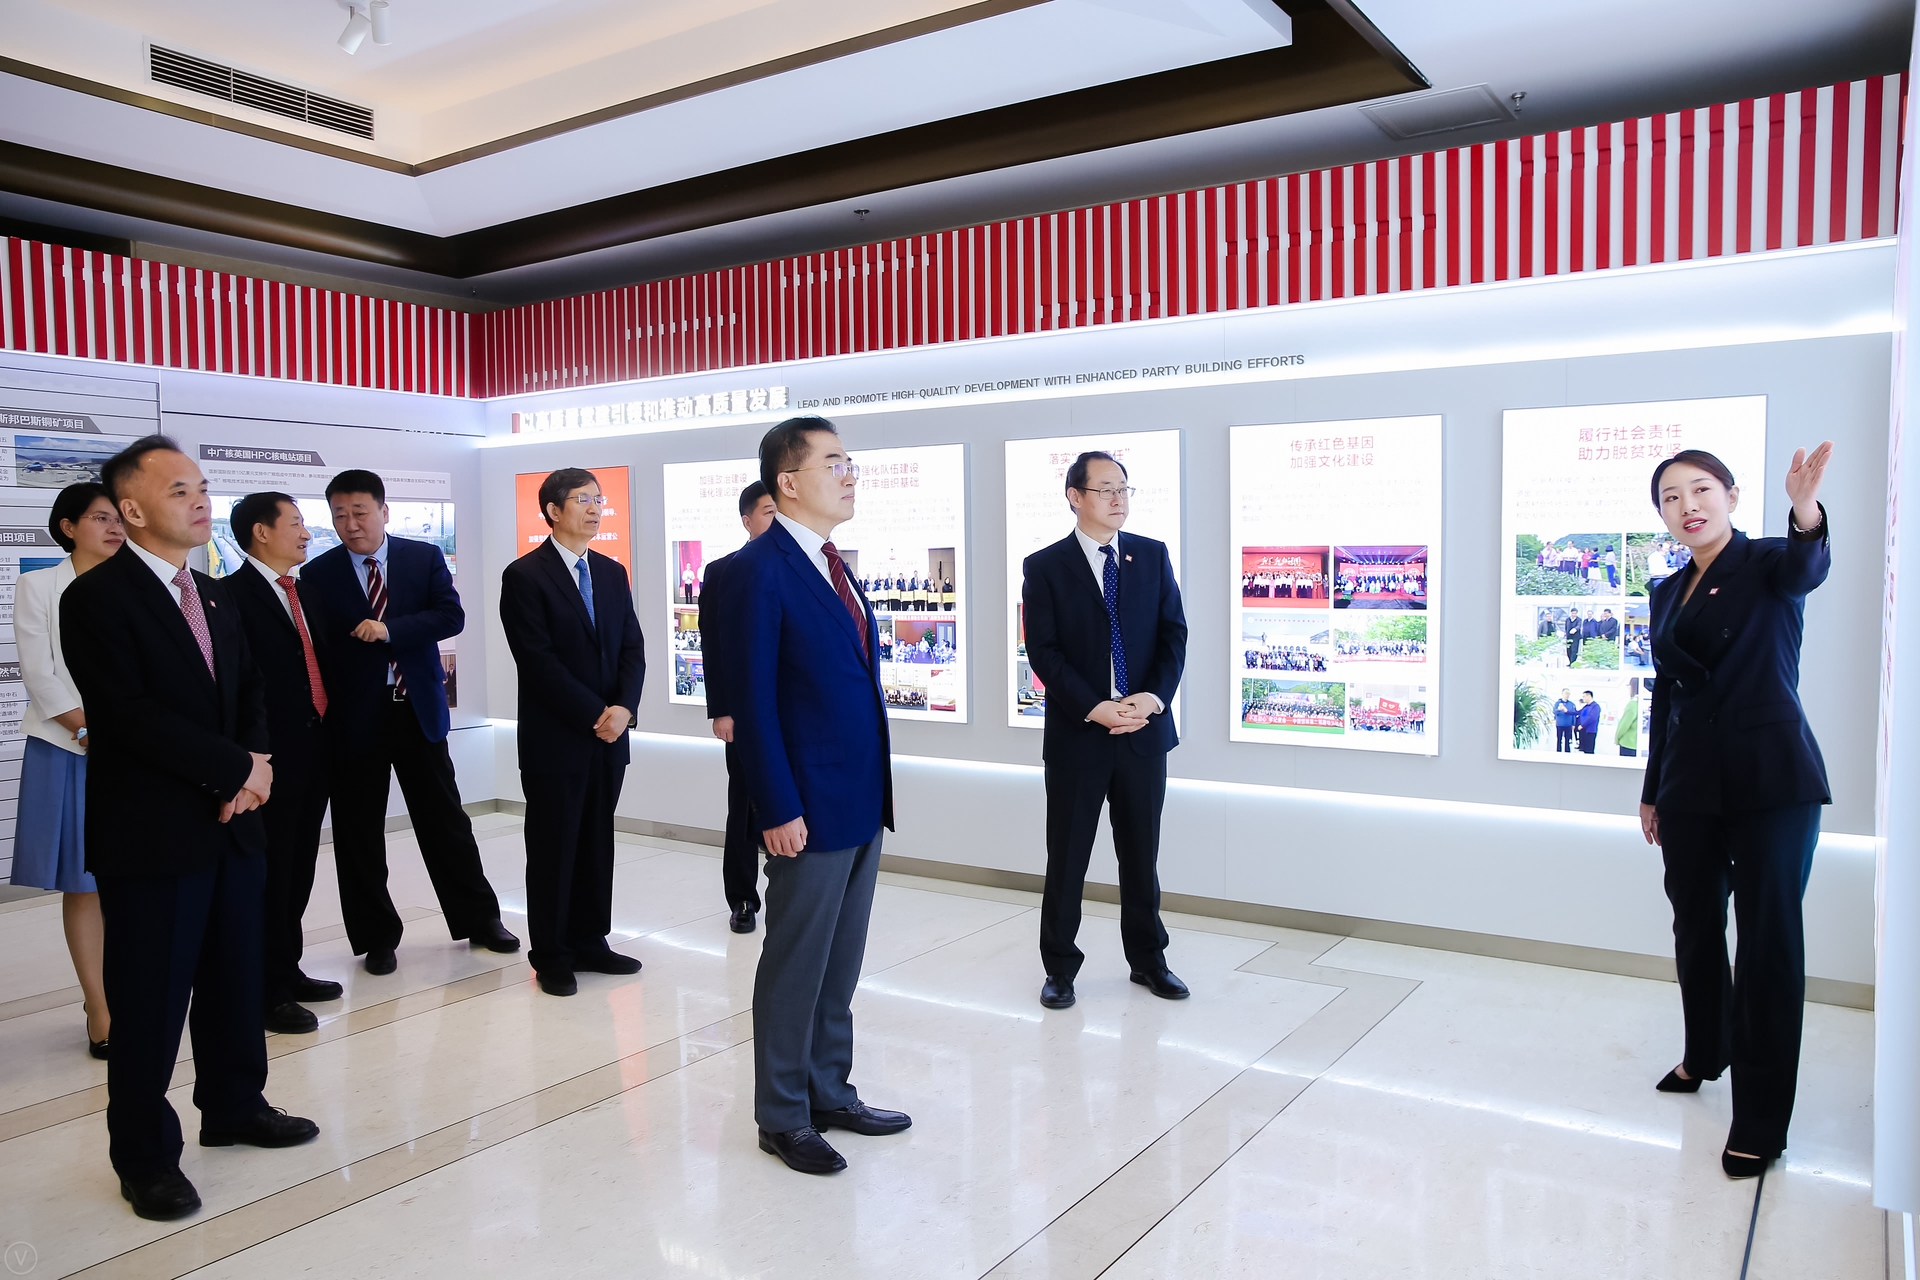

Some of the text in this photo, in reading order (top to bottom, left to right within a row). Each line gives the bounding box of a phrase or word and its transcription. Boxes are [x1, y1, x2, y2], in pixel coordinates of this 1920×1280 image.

[797, 354, 1305, 409] LEAD AND PROMOTE HIGH-QUALITY DEVELOPMENT WITH ENHANCED PARTY BUILDING EFFORTS
[520, 386, 789, 433] 以高质量党建引领和推动高质量发展
[1578, 424, 1683, 443] 履行社会责任
[1290, 436, 1374, 452] 传承红色基因
[1578, 443, 1682, 461] 助力脱贫攻坚
[207, 447, 312, 463] 中广核英国HPC核电站项目
[1290, 453, 1374, 469] 加强文化建设
[861, 462, 919, 476] 强化队伍建设
[861, 477, 920, 490] 打牢组织基础
